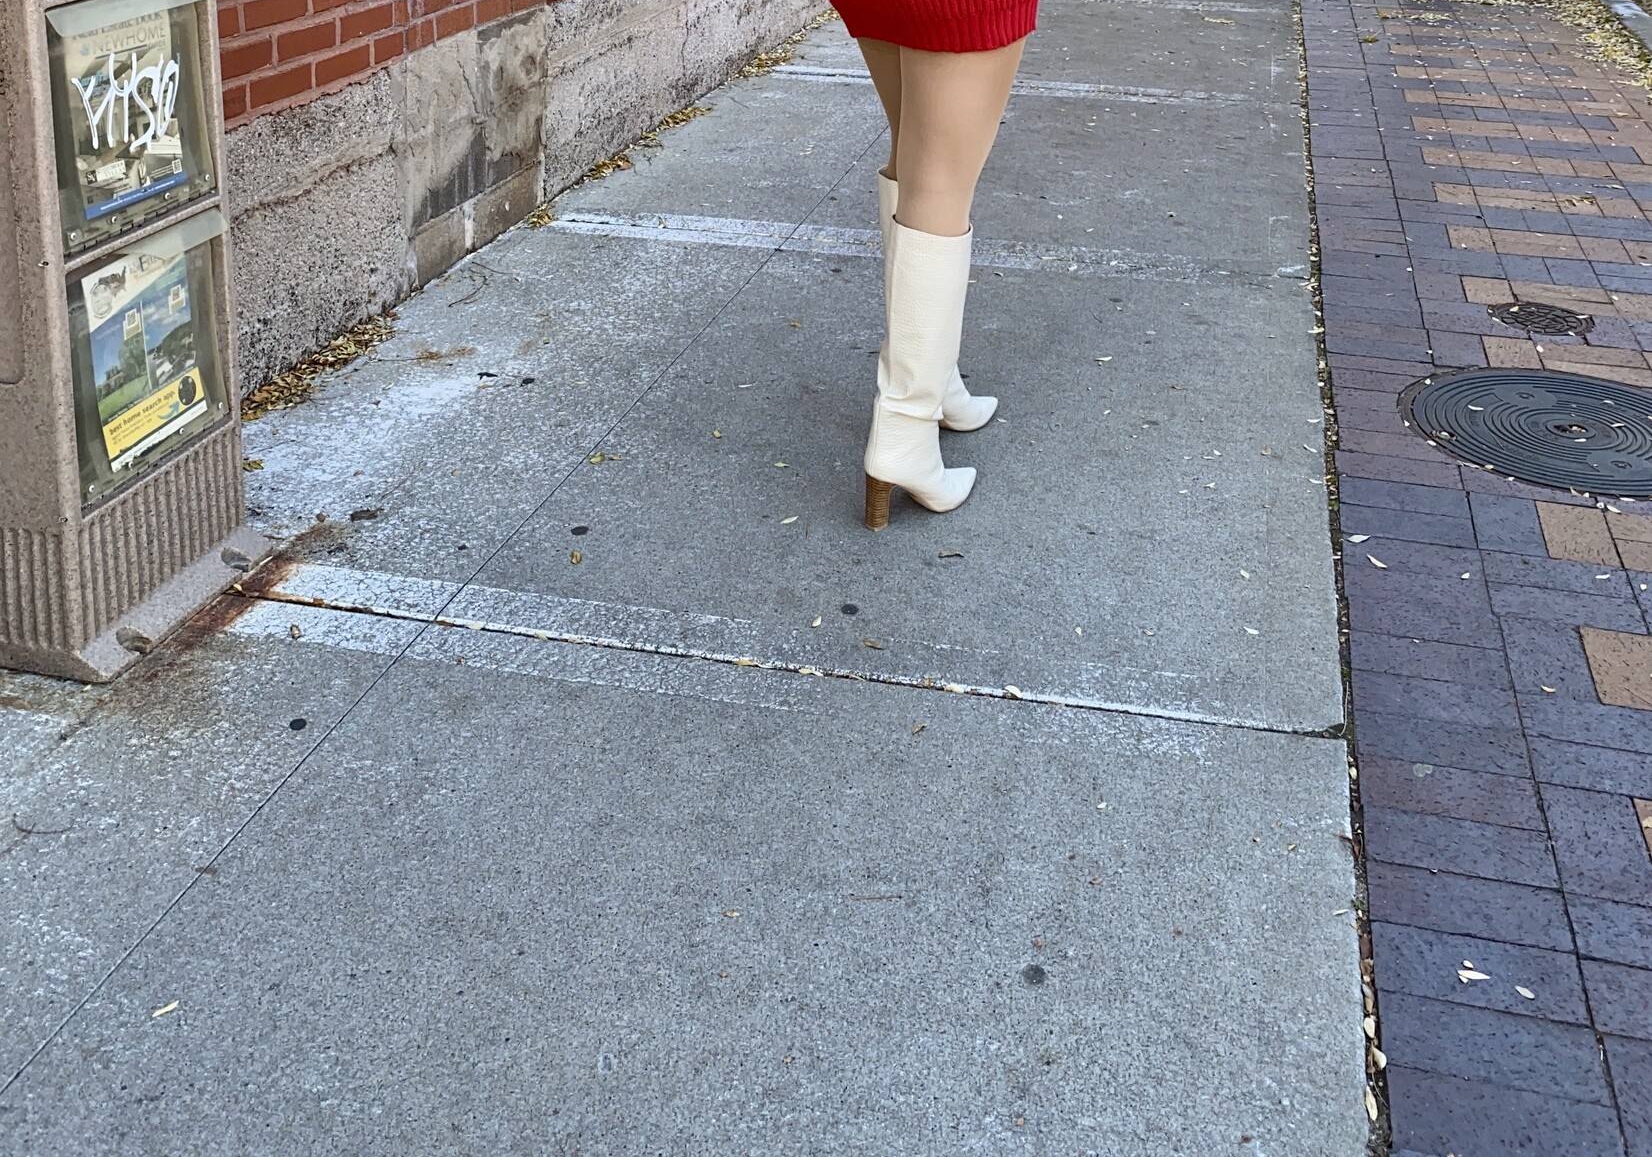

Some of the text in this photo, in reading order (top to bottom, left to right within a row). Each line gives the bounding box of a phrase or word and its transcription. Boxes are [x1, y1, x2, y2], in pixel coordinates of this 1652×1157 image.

[109, 422, 123, 436] best
[123, 411, 141, 426] home
[142, 397, 162, 414] search
